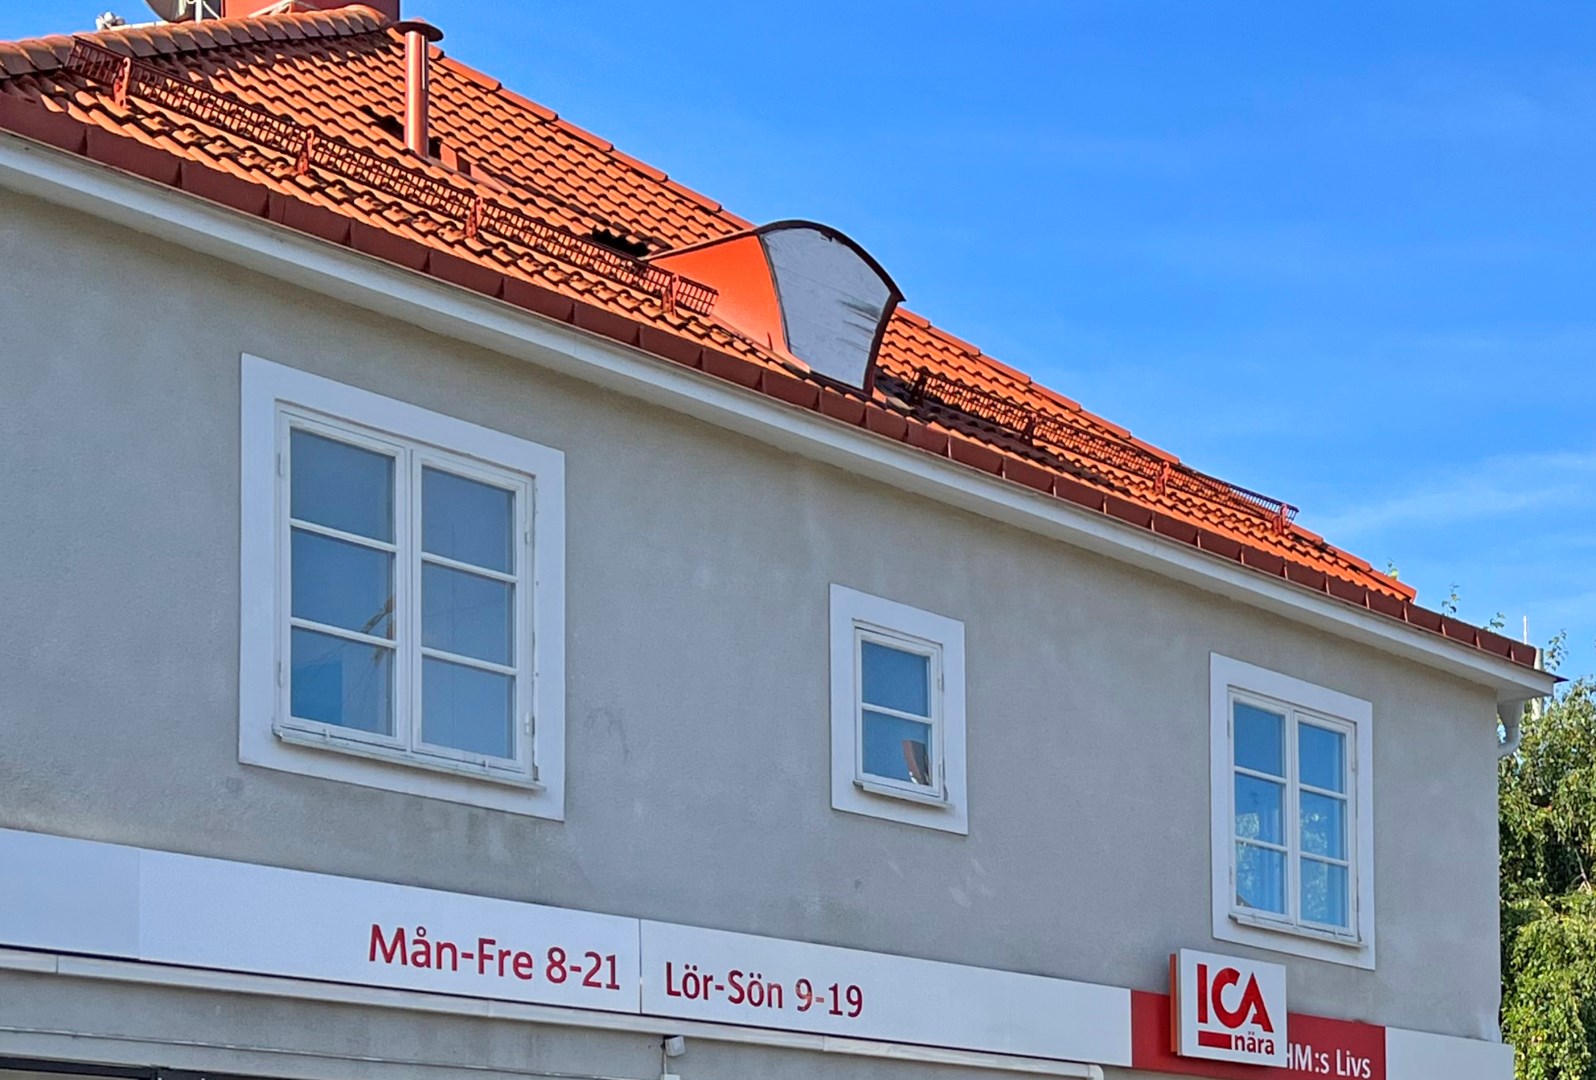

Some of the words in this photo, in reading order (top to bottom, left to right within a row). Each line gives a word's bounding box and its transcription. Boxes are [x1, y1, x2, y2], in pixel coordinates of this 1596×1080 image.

[368, 924, 533, 980] Mån-Fre
[546, 946, 621, 991] 8-21
[665, 961, 783, 1009] Lör-Sön
[795, 978, 864, 1018] 9-19
[1196, 963, 1274, 1033] ICA
[1234, 1031, 1275, 1055] nära
[1336, 1049, 1372, 1079] Livs
